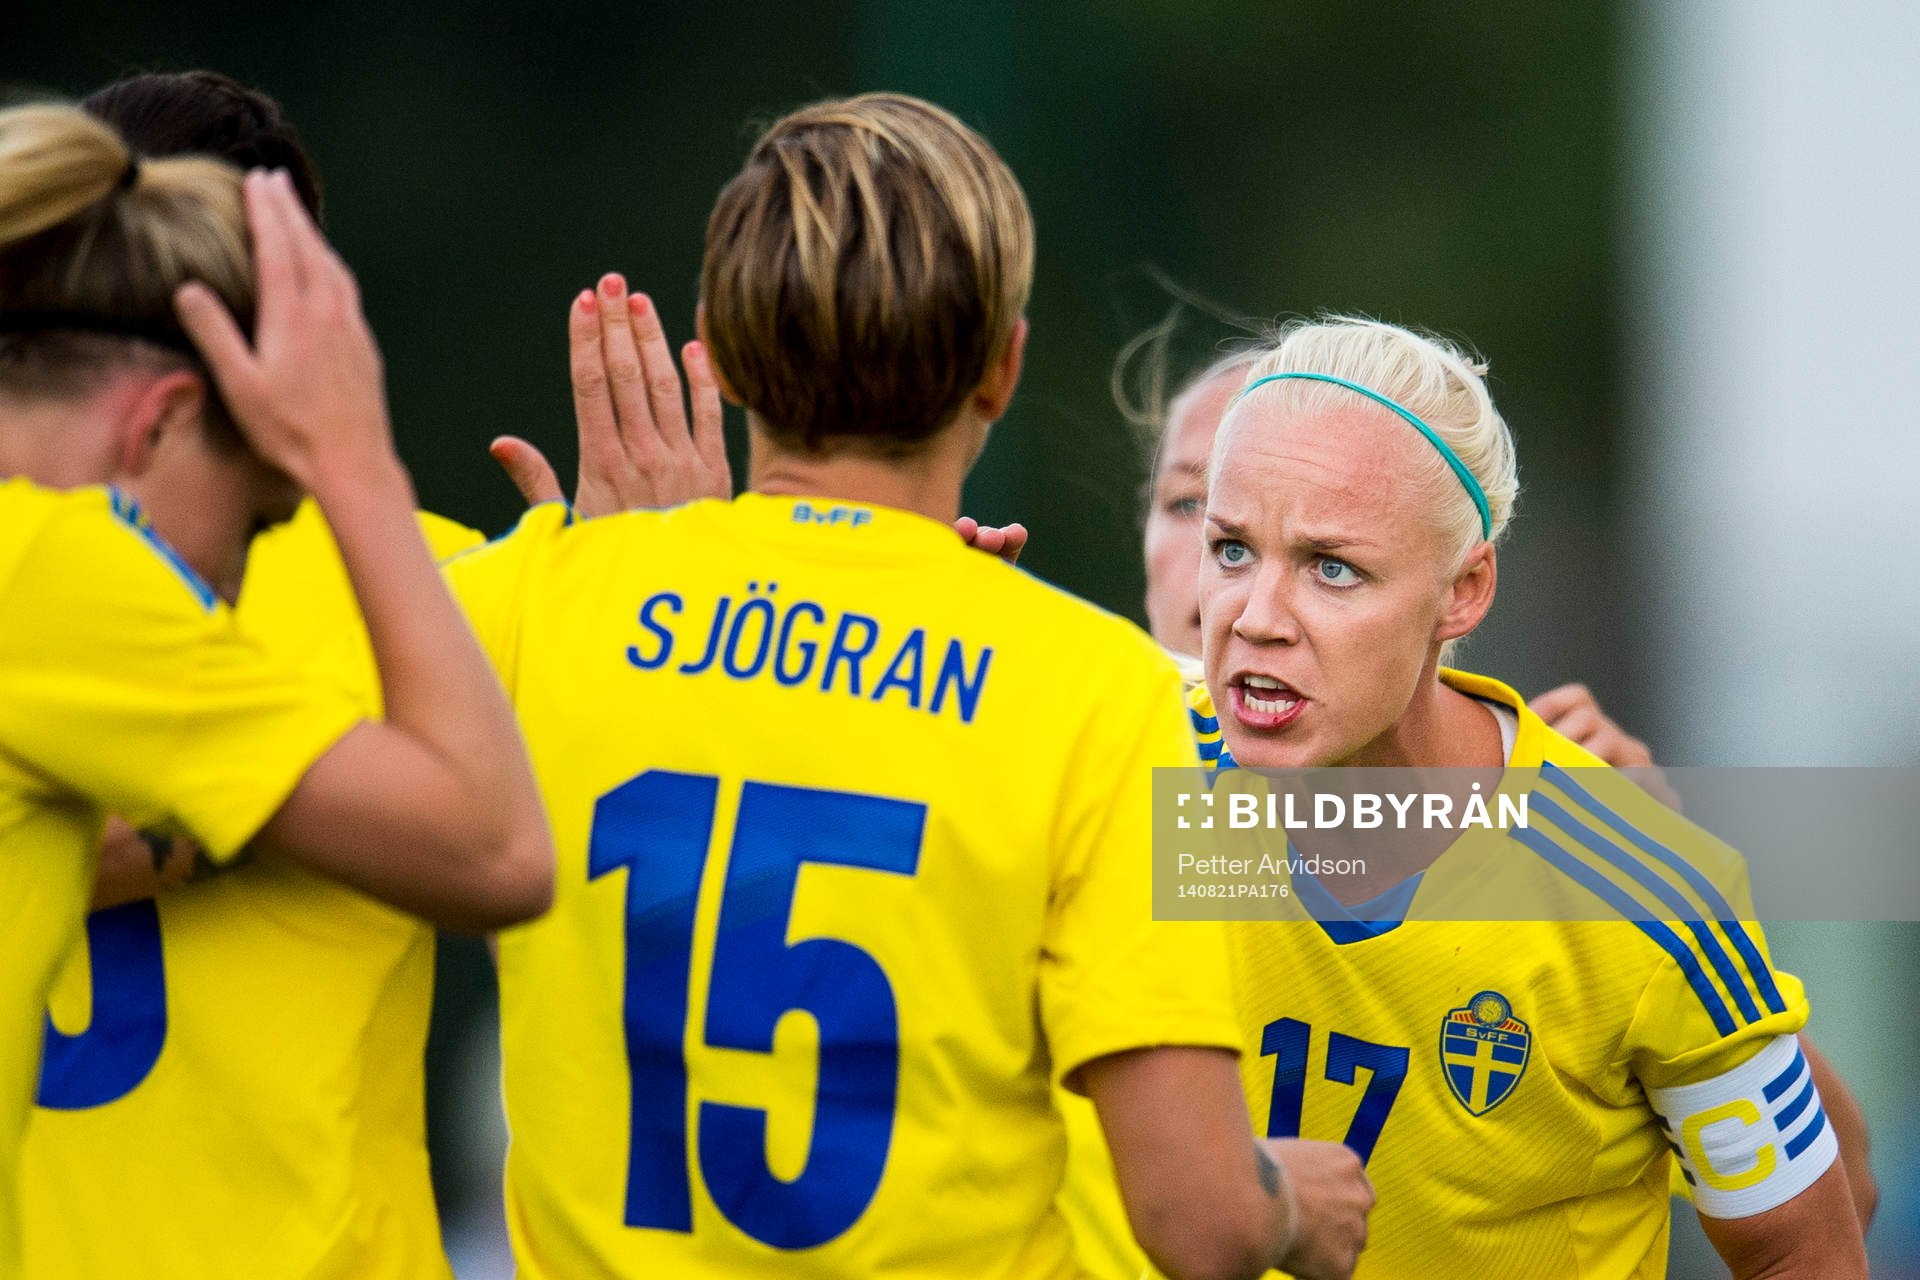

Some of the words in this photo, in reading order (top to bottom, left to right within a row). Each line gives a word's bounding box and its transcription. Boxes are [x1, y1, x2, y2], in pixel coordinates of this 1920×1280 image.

[626, 581, 993, 724] SJÖGRAN
[587, 768, 928, 1251] 15
[1466, 1027, 1509, 1042] SvFF
[1260, 1017, 1410, 1169] 17
[1681, 1099, 1777, 1191] C
